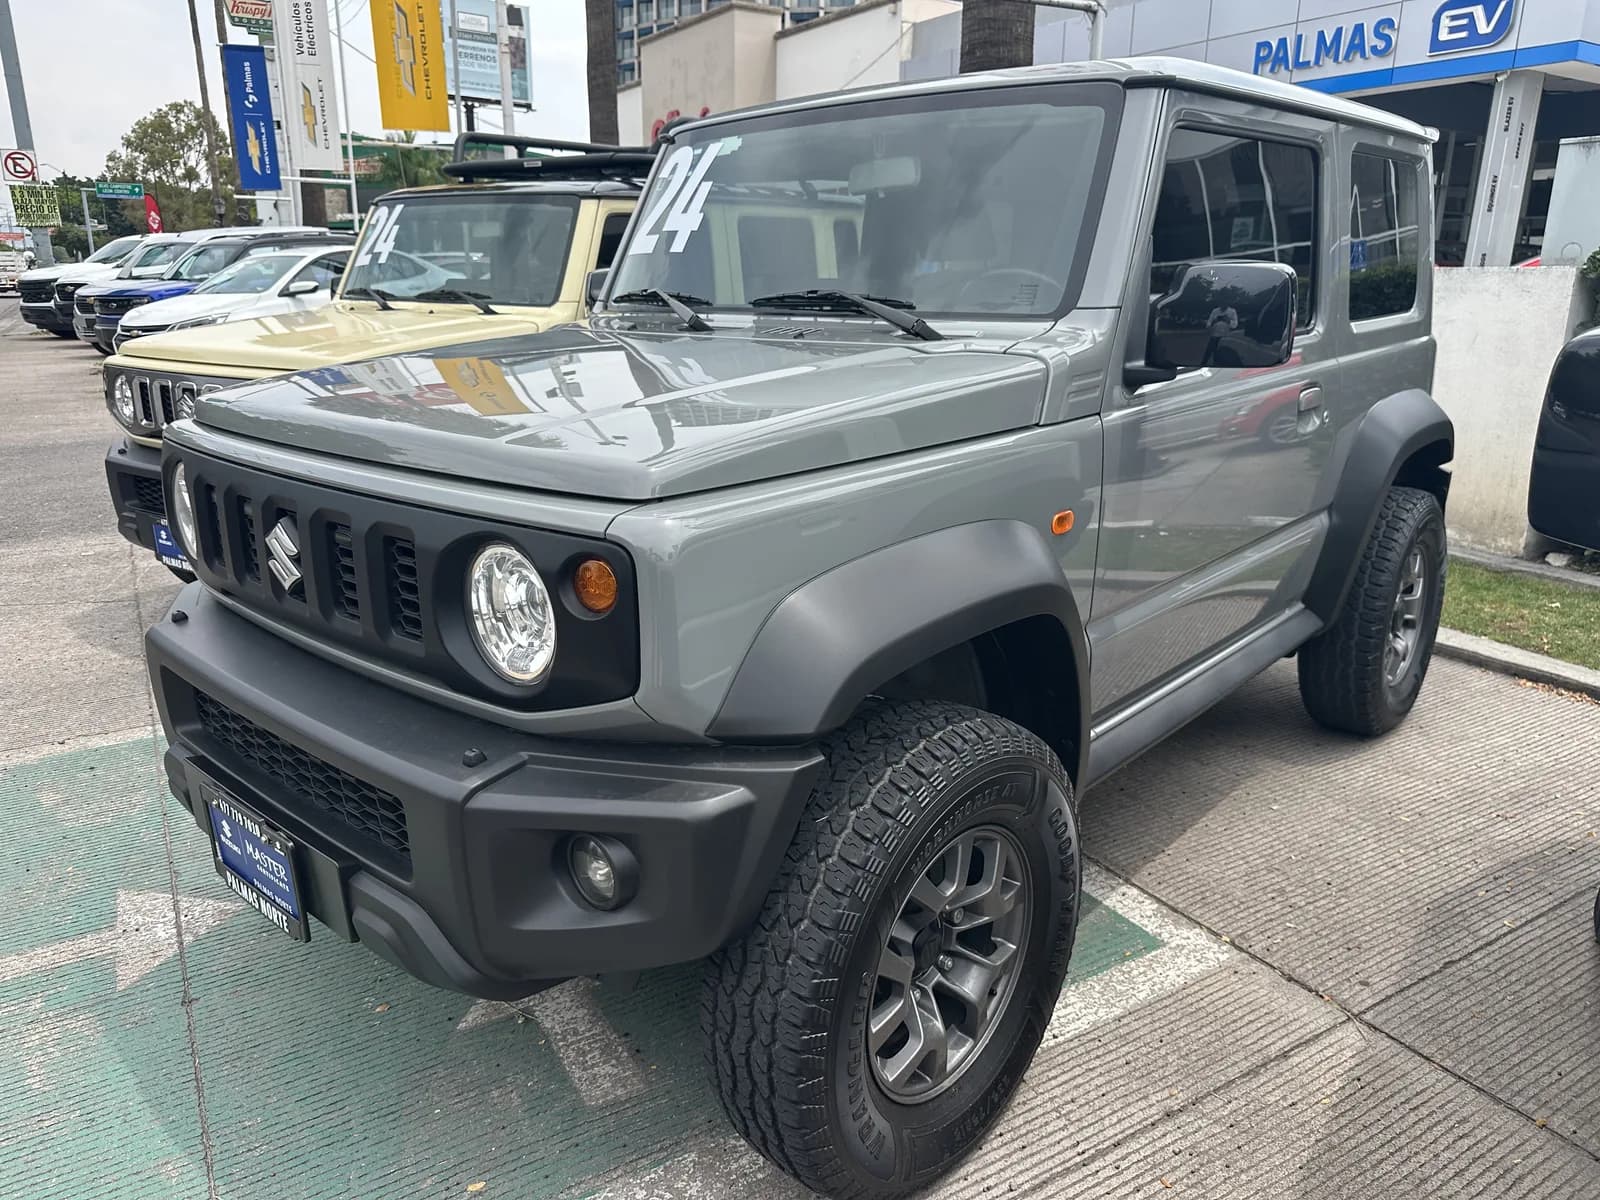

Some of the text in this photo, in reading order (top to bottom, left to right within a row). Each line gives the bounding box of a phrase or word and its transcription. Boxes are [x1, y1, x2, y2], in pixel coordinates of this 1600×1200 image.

[231, 0, 267, 18] Krispy
[305, 1, 317, 57] Eléctricos
[1437, 0, 1509, 42] EV
[417, 4, 432, 100] CHEVROLET
[458, 51, 497, 64] ERRENOS
[1253, 16, 1398, 75] PALMAS
[243, 61, 254, 93] Palmas
[318, 77, 330, 150] CHEVROLET
[260, 121, 271, 174] CHEVROLET
[14, 204, 59, 213] PRECIO DE
[27, 190, 43, 198] MIN
[629, 142, 724, 256] 24
[355, 204, 405, 267] 24
[245, 839, 288, 881] MASTER
[226, 870, 290, 933] PALMAS NORTE
[254, 878, 275, 900] PALMAS
